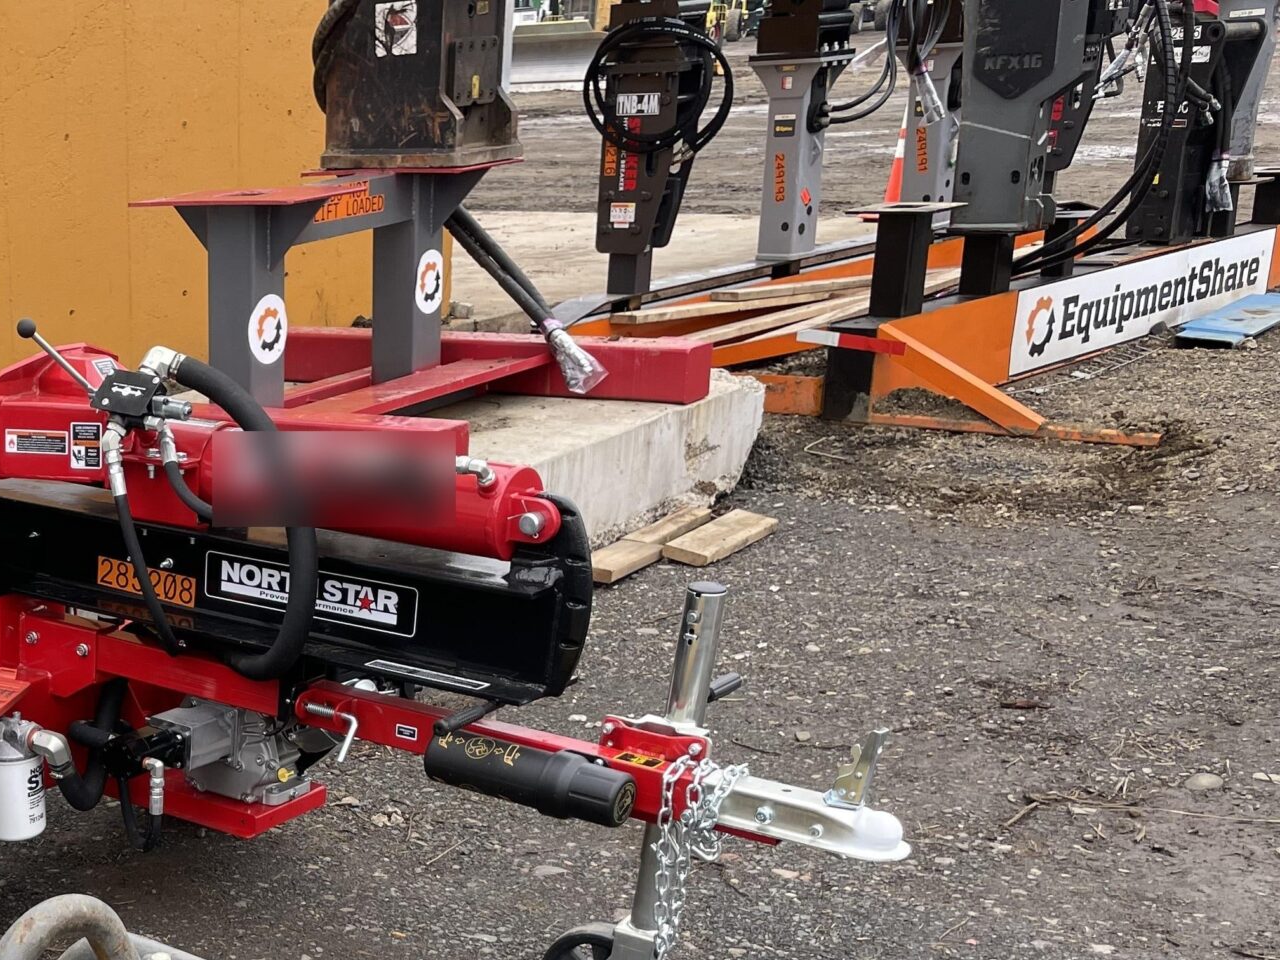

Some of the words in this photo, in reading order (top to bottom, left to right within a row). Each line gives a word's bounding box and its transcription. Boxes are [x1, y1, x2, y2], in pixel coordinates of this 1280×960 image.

[618, 94, 660, 115] TNB-4M
[623, 116, 641, 191] STKER
[775, 153, 785, 202] 249193
[346, 195, 384, 216] LOADED
[1058, 256, 1260, 344] EquipmentShare
[221, 560, 319, 598] NORT
[322, 580, 399, 613] STAR
